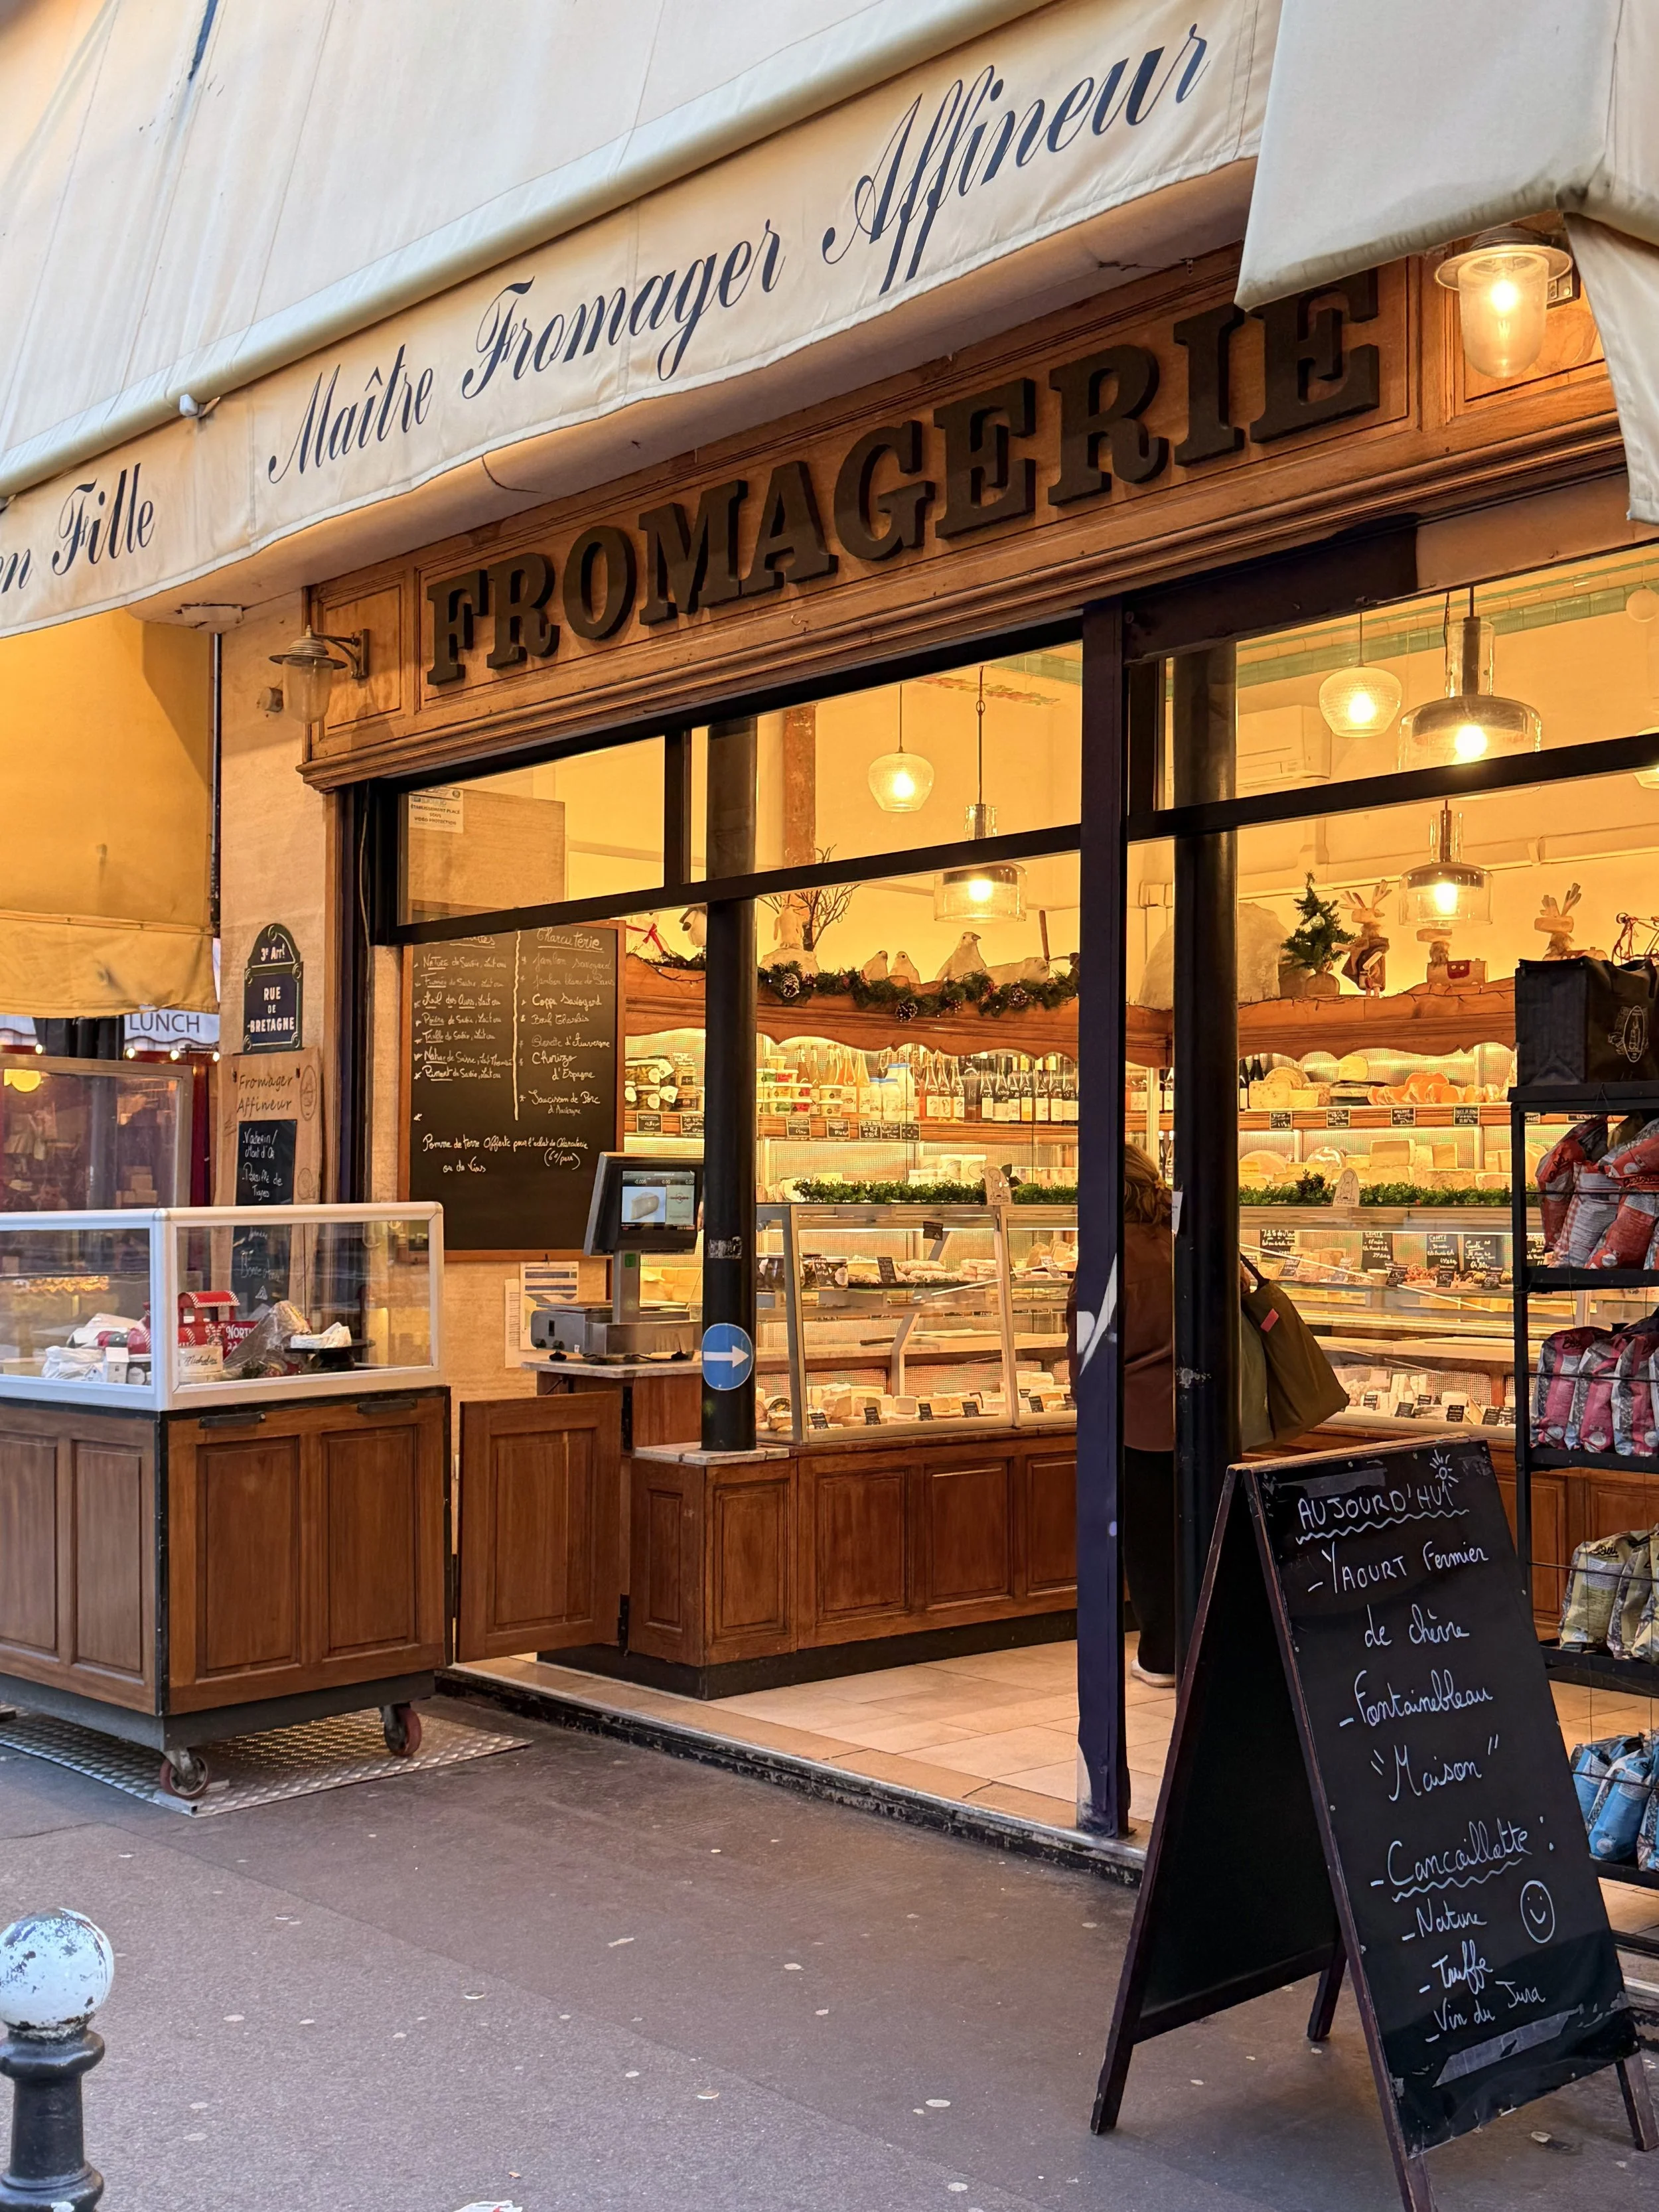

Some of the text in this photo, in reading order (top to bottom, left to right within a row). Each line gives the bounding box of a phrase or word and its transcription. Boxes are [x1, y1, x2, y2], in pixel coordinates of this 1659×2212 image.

[52, 463, 155, 575] Fille
[268, 344, 433, 484] Maître
[462, 219, 786, 399] Fromager
[822, 24, 1210, 296] Affineur
[427, 269, 1380, 686] FROMAGERIE
[263, 987, 281, 1001] RUE
[267, 1004, 276, 1013] DE
[129, 1013, 200, 1033] LUNCH
[250, 1017, 295, 1033] BRETAGNE
[239, 1075, 293, 1092] Fromager
[237, 1097, 292, 1118] Affineur
[423, 1134, 452, 1151] Pomme
[453, 1138, 462, 1149] de
[273, 1173, 283, 1186] de
[1297, 1481, 1453, 1530] AUJOURD'HUI
[1423, 1541, 1489, 1572] Fermier
[1364, 1604, 1392, 1647] de
[1354, 1670, 1493, 1726] Fontainebleau
[1415, 1898, 1487, 1938] Nature
[1431, 1939, 1493, 1995] Truffe
[1433, 1980, 1546, 2031] Vin du Jura
